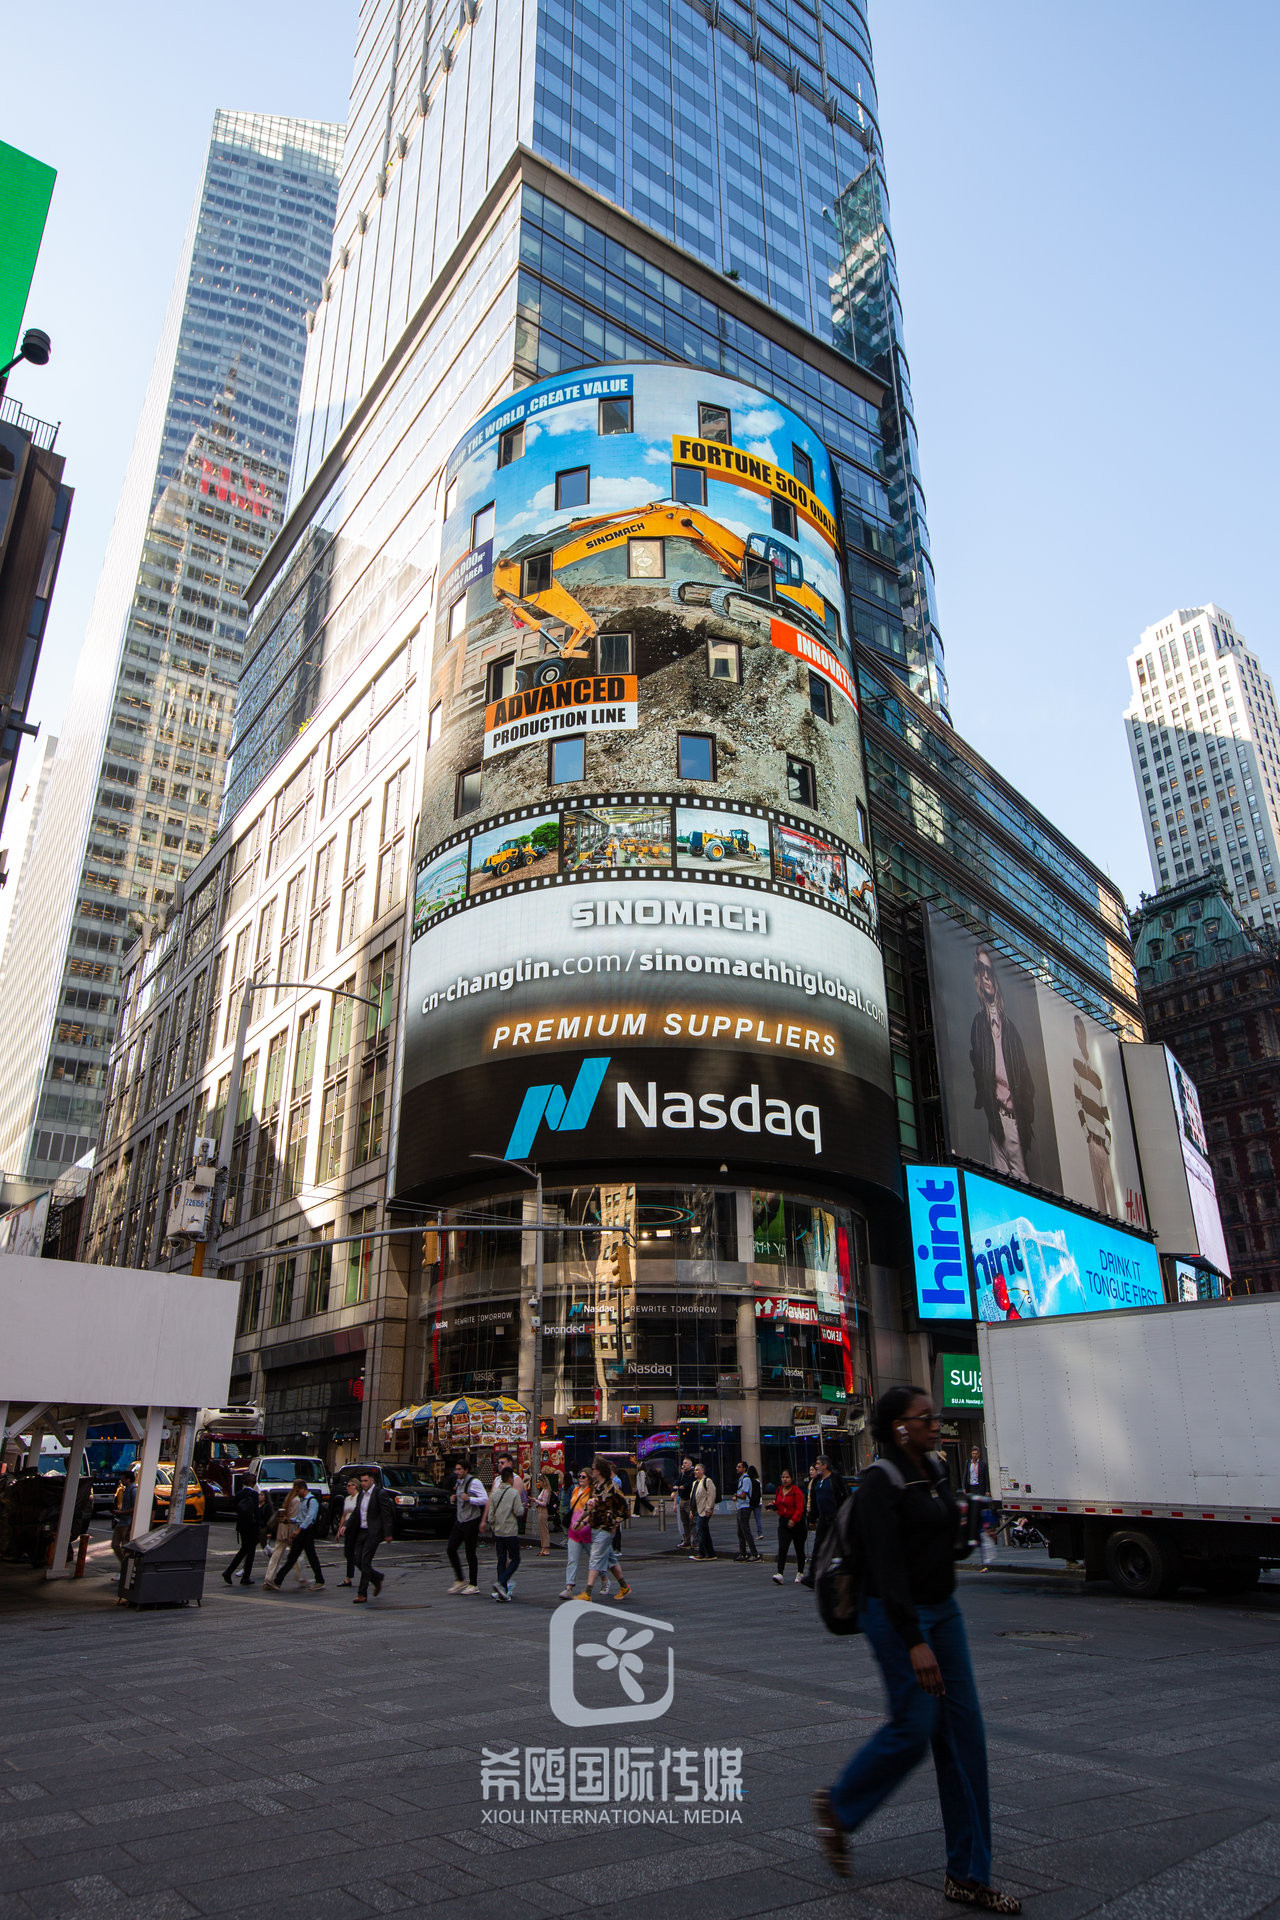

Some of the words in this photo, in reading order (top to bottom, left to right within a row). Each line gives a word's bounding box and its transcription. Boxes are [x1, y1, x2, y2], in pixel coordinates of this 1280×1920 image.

[467, 433, 484, 455] THE
[485, 404, 525, 439] WORLD
[583, 378, 628, 396] VALUE
[679, 440, 772, 486] FORTUNE
[775, 470, 808, 508] 500
[810, 499, 838, 543] QUALIT
[585, 521, 646, 550] SINOMACH
[463, 564, 484, 585] AREA
[493, 676, 626, 728] ADVANCED
[492, 711, 588, 749] PRODUCTION
[590, 707, 626, 725] LINE
[571, 899, 769, 935] SINOMACH
[492, 1012, 647, 1050] PREMIUM
[663, 1012, 837, 1057] SUPPLIERS
[615, 1080, 823, 1155] Nasdaq
[1125, 1187, 1145, 1228] H&M
[917, 1179, 966, 1305] hint
[972, 1232, 1024, 1290] hint
[1099, 1248, 1132, 1278] DRINK
[1132, 1260, 1141, 1281] IT
[1085, 1270, 1132, 1303] TONGUE
[1132, 1286, 1158, 1306] FIRST
[454, 1316, 475, 1326] REWRITE
[478, 1311, 512, 1322] TOMORROW
[583, 1304, 615, 1314] Nasdaq
[630, 1305, 667, 1313] REWRITE
[671, 1305, 718, 1314] TOMORROW
[627, 1362, 672, 1376] Nasdaq
